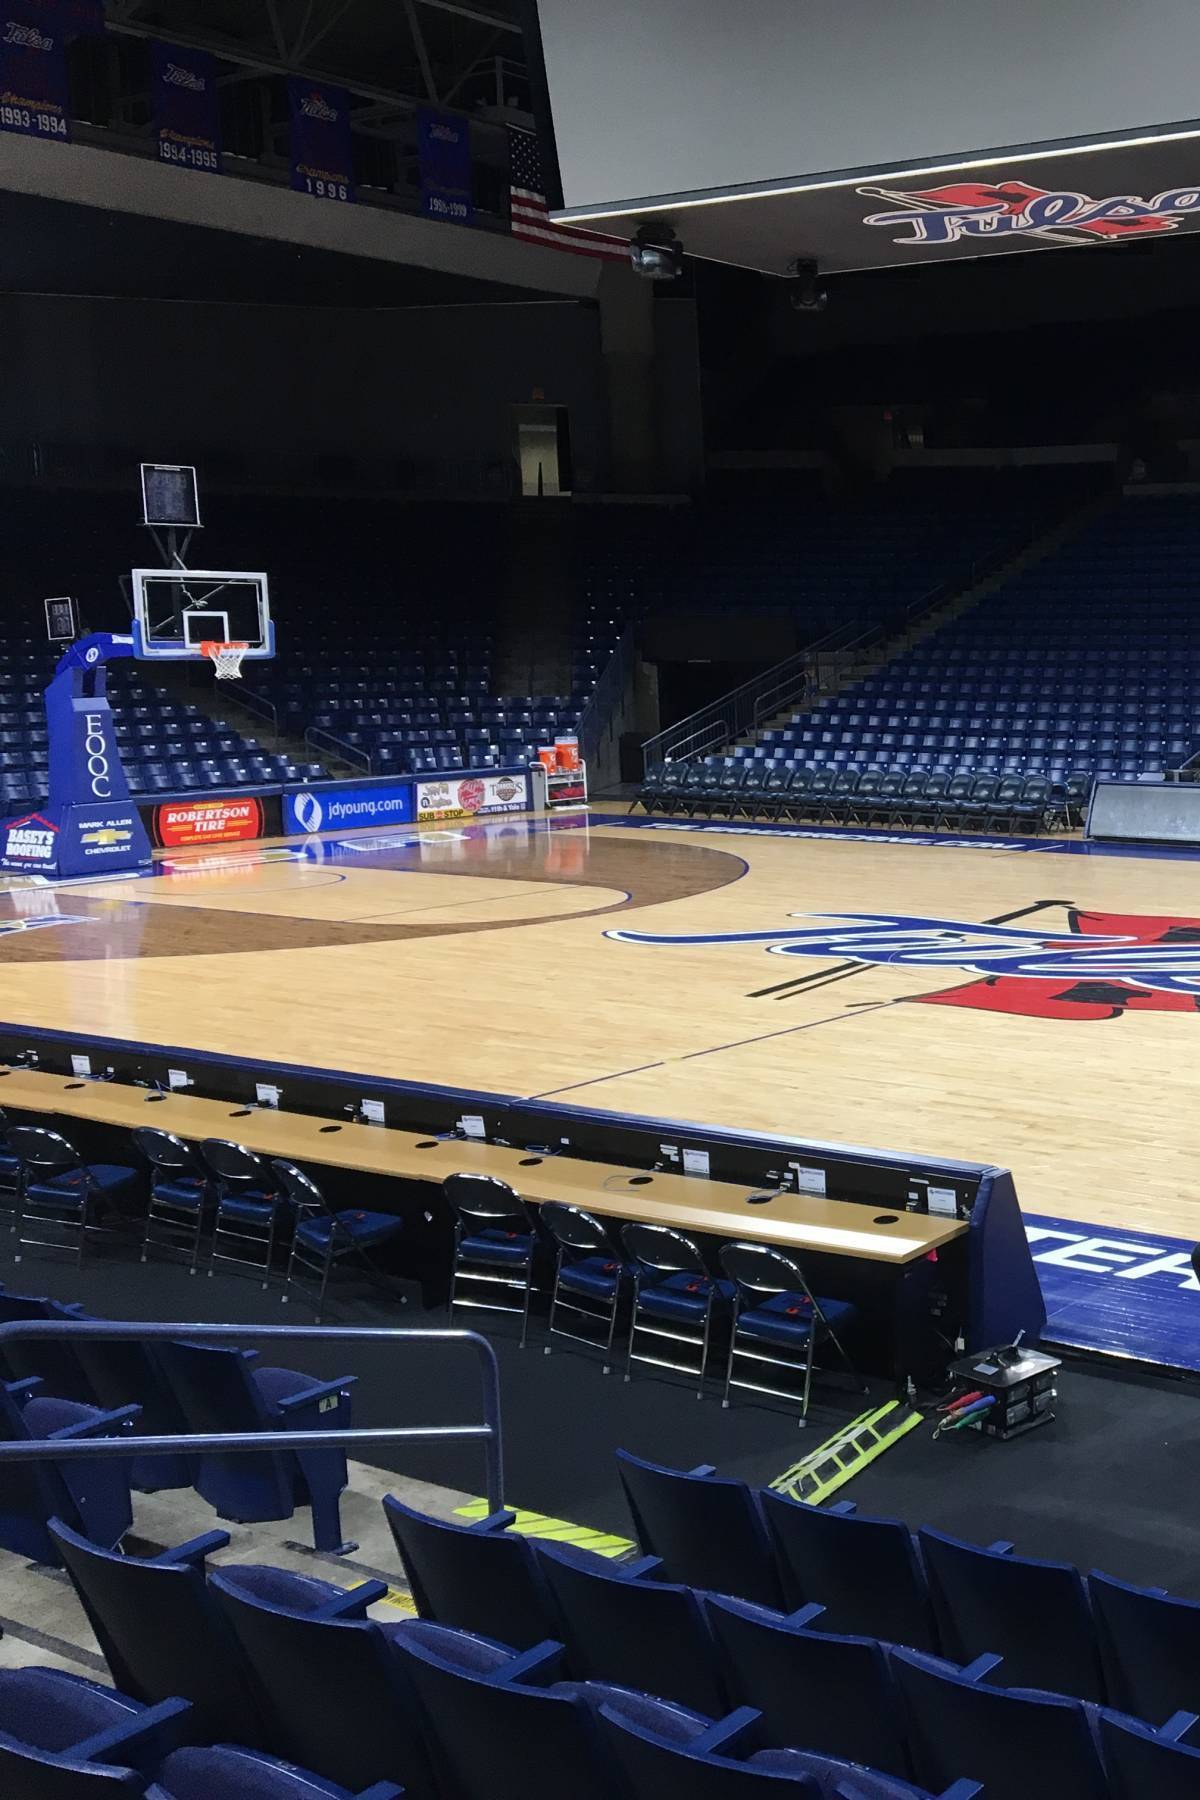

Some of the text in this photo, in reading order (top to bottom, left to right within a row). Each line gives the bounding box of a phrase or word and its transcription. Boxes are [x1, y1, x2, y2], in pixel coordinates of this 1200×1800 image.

[1, 22, 54, 51] Tulsa
[0, 106, 67, 136] 1993-1994
[159, 141, 217, 168] 1994-1995
[85, 714, 111, 797] EOOC
[167, 807, 250, 823] ROBERTSON
[328, 799, 403, 820] jdyoung.com
[419, 809, 464, 820] SUB STOP
[106, 819, 133, 827] ALLEN
[194, 819, 226, 832] TIRE
[8, 829, 55, 846] BASEY'S
[6, 843, 52, 858] ROOFING
[85, 845, 132, 855] CHEVROLET
